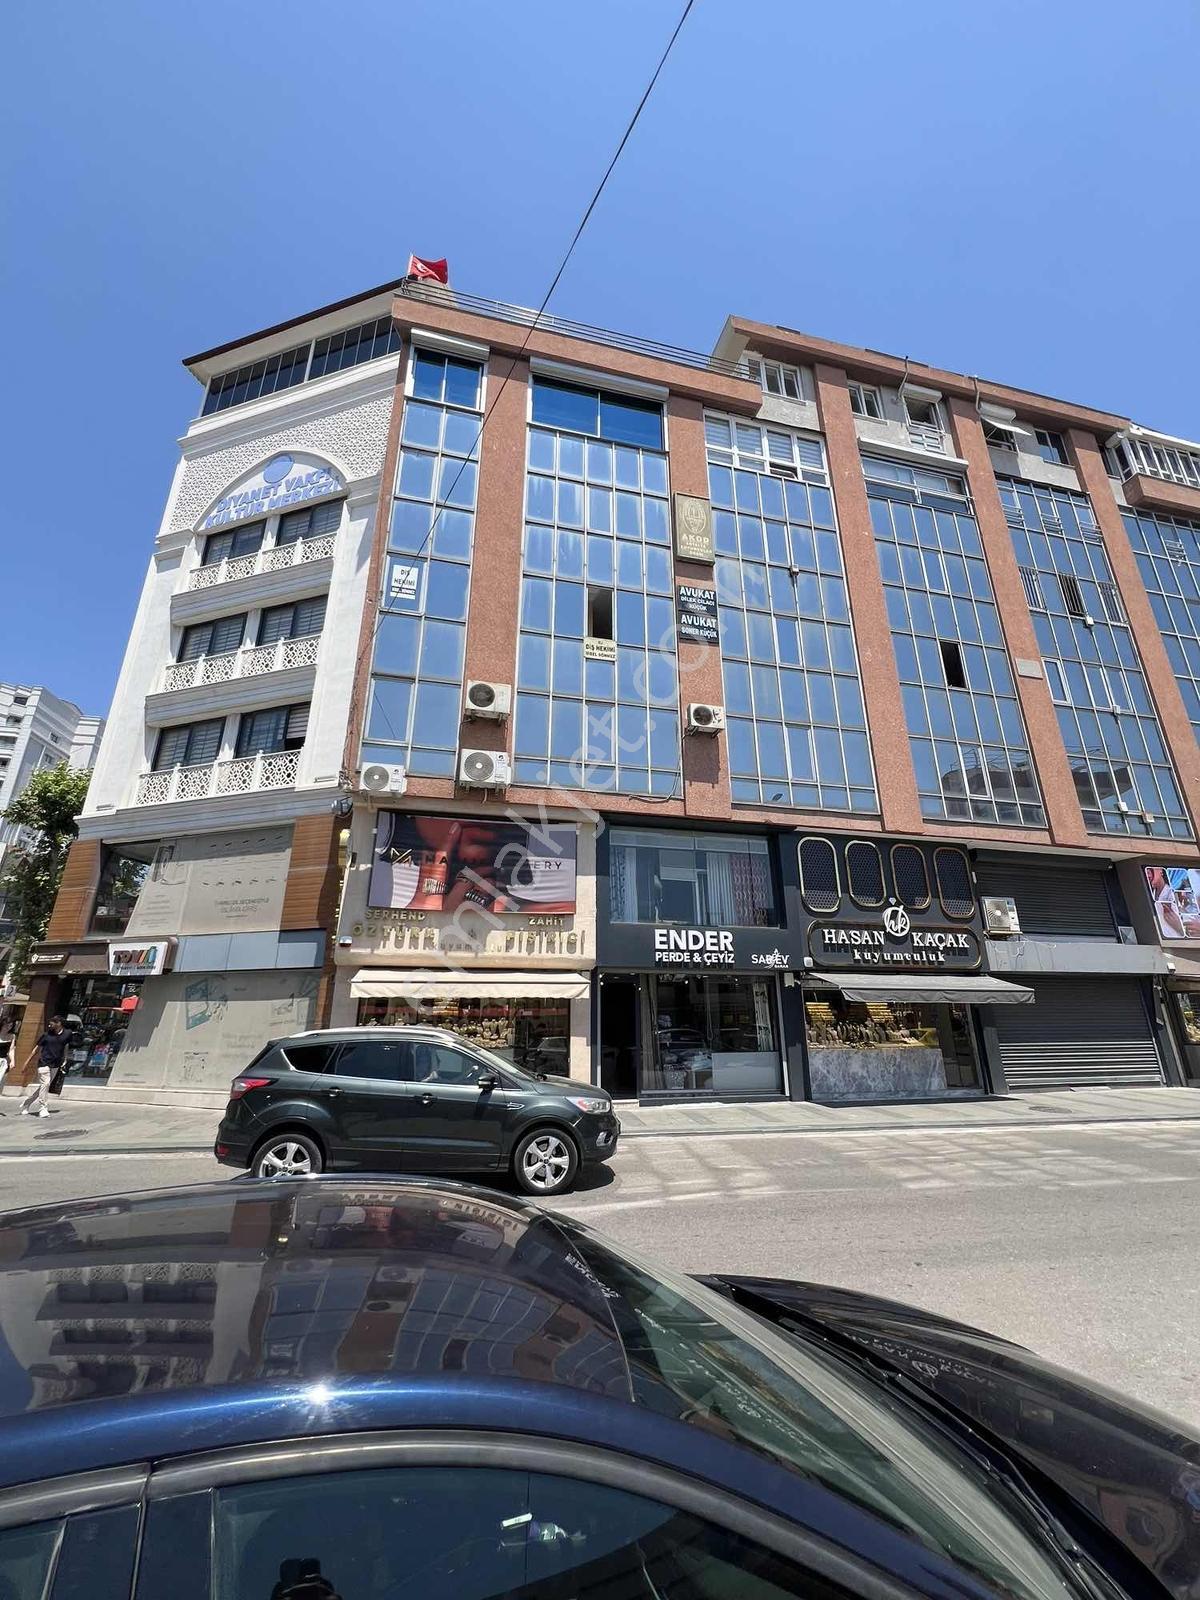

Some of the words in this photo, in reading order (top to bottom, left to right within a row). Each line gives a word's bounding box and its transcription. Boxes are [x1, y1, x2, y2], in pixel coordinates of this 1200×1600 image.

[680, 586, 715, 600] AVUKAT
[680, 614, 717, 629] AVUKAT
[699, 627, 718, 639] KÜÇÜK
[365, 909, 426, 921] SERHEND
[528, 916, 565, 929] ZAHİT
[654, 929, 735, 951] ENDER
[822, 929, 886, 945] HASAN
[911, 932, 970, 951] KAÇAK
[655, 952, 691, 963] PERDE
[692, 953, 702, 963] &
[704, 950, 735, 966] ÇEYİZ
[853, 949, 946, 963] kuyumculuk
